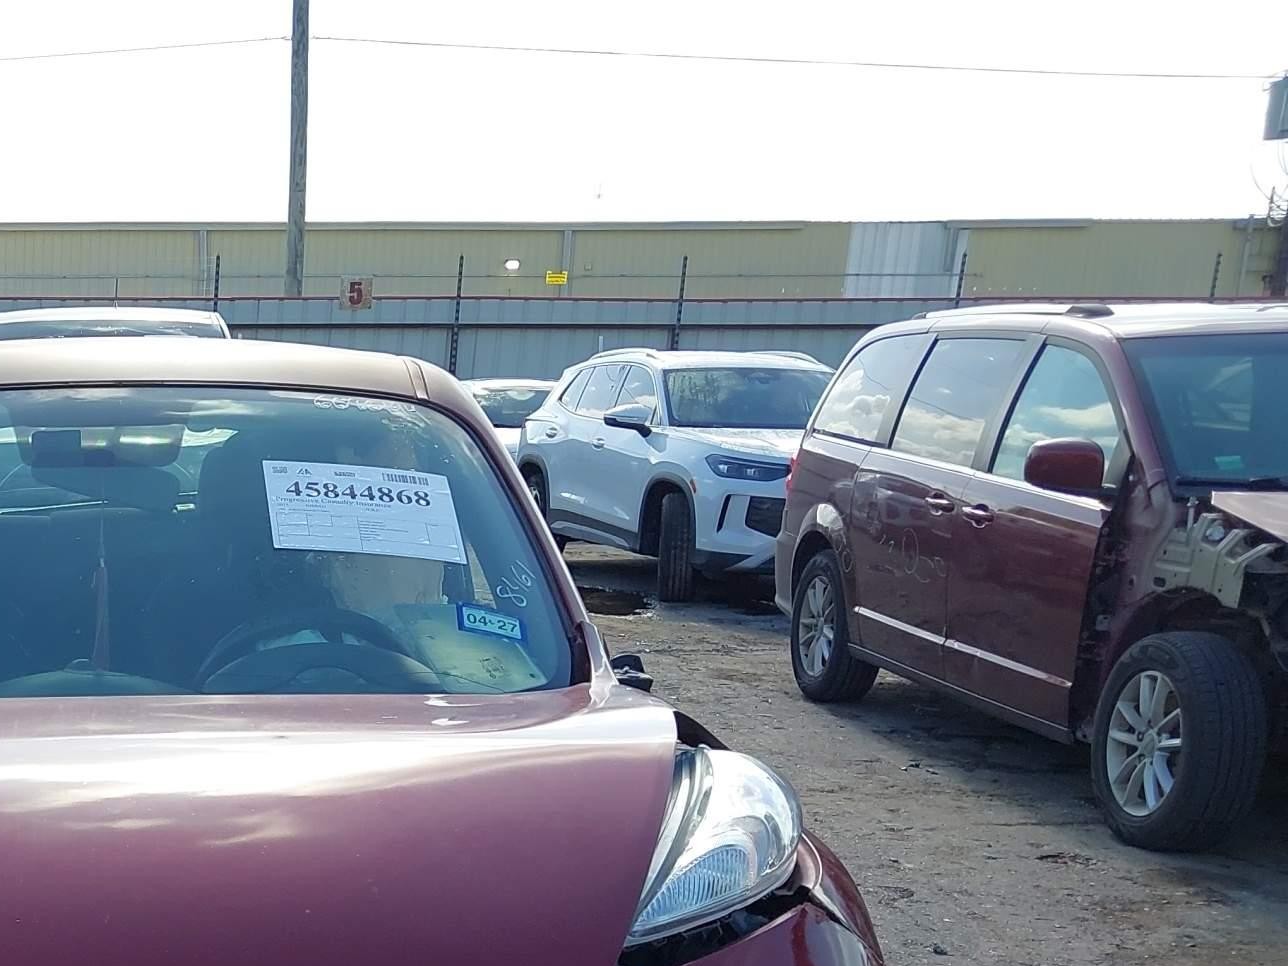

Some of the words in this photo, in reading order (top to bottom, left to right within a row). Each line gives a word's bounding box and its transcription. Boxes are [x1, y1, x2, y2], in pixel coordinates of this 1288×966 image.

[349, 281, 362, 305] 5
[285, 480, 432, 508] 45844868
[466, 613, 519, 633] 04-27
